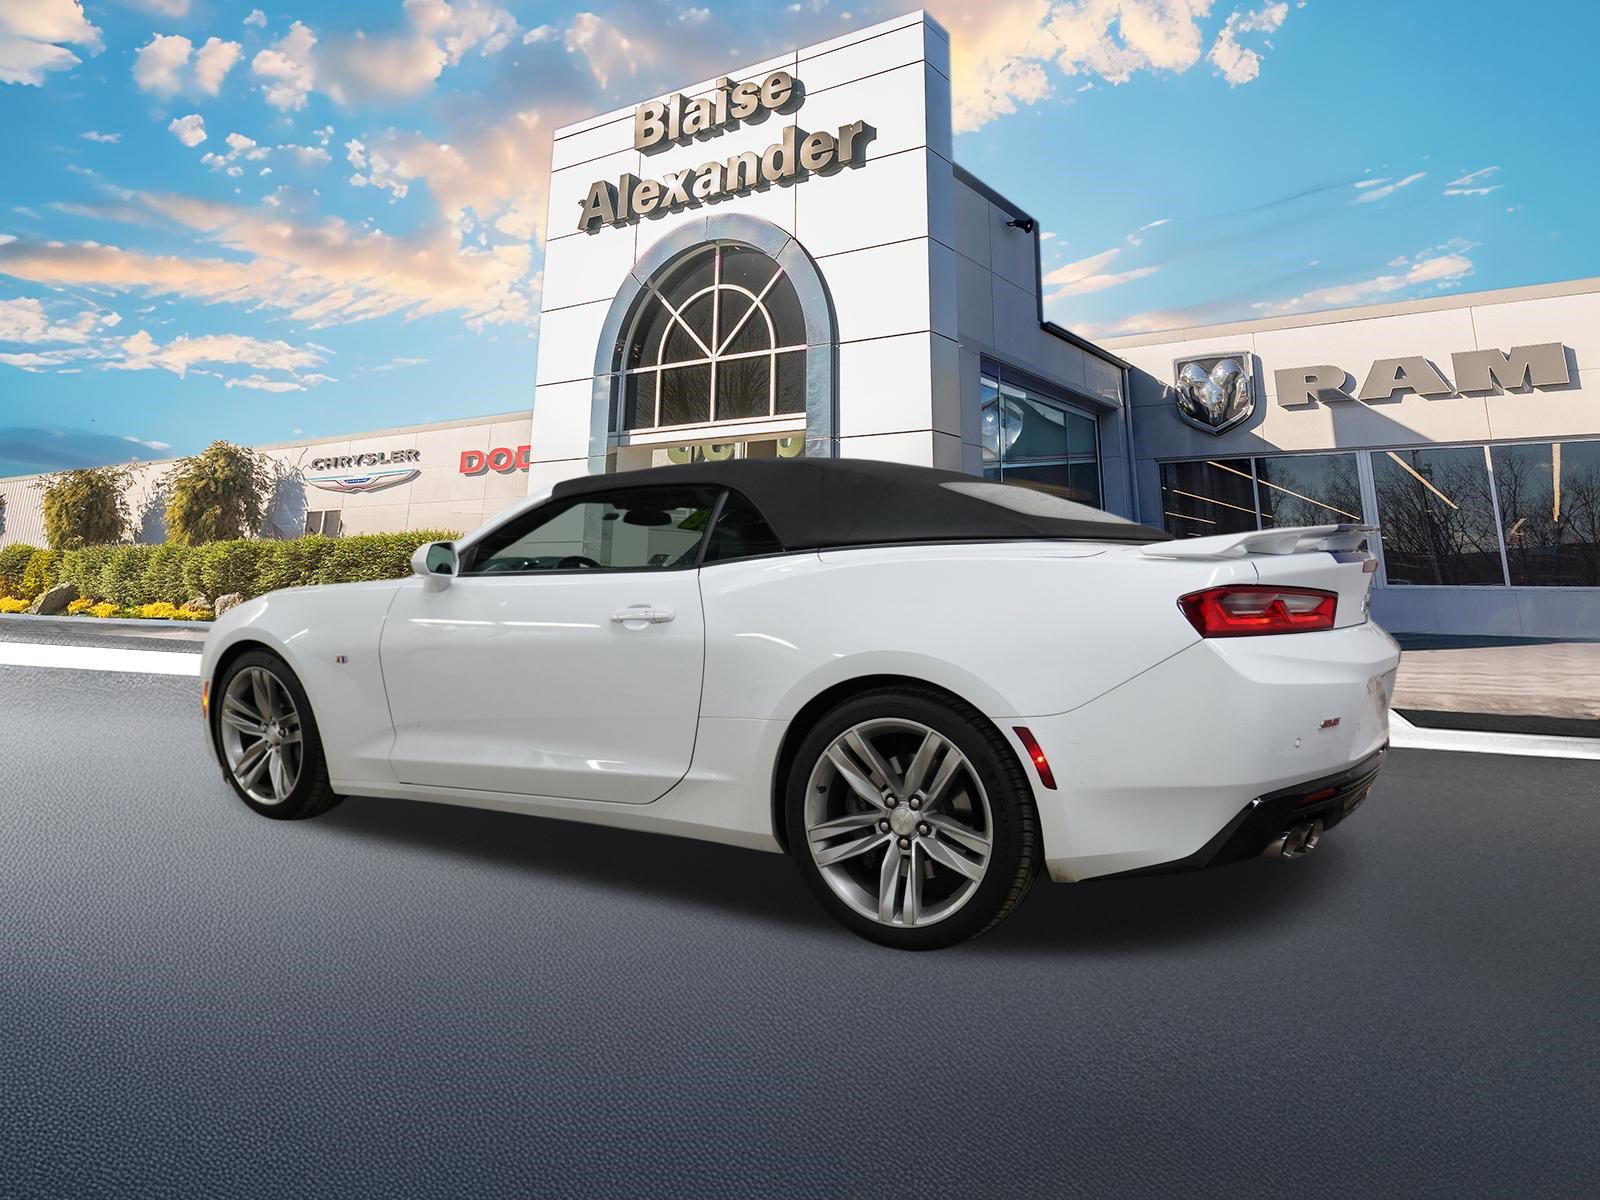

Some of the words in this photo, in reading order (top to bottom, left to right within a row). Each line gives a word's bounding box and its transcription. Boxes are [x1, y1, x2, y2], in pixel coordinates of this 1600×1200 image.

[635, 71, 803, 155] Blaise
[577, 120, 874, 234] Alexander
[1274, 342, 1573, 408] RAM
[311, 448, 420, 471] CHRYSLER
